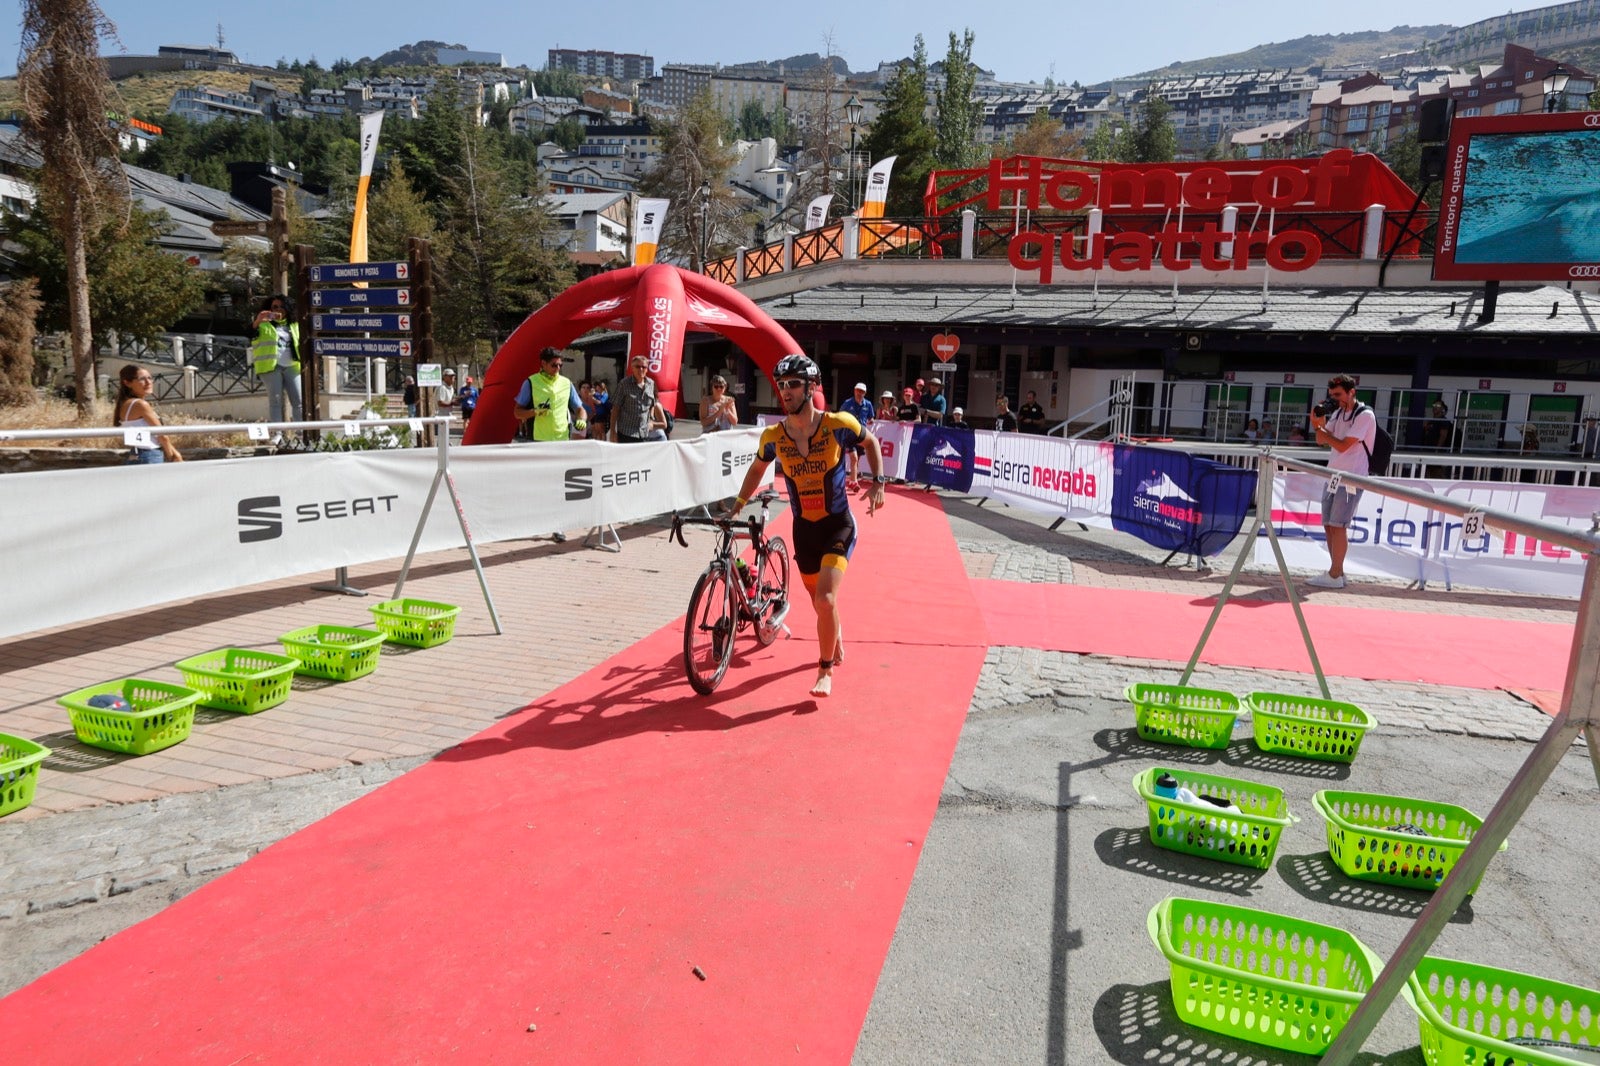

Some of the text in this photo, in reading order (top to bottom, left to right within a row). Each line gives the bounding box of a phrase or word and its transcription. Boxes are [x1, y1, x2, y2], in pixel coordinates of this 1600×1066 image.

[987, 148, 1353, 210] Home of
[1441, 145, 1465, 253] Territorio quattro
[1008, 222, 1322, 284] quattro
[334, 267, 379, 277] REMONTES Y PISTAS
[335, 318, 382, 327] PARKING AUTOBUSES
[322, 343, 335, 351] ZONA
[336, 342, 362, 351] RECREATIVA
[136, 432, 143, 443] 4
[256, 427, 263, 437] 3
[350, 424, 356, 434] 2
[789, 460, 827, 477] ZAPATERO
[601, 469, 651, 489] SEAT
[1330, 477, 1339, 495] 62
[296, 494, 399, 523] SEAT
[1465, 517, 1479, 535] 63
